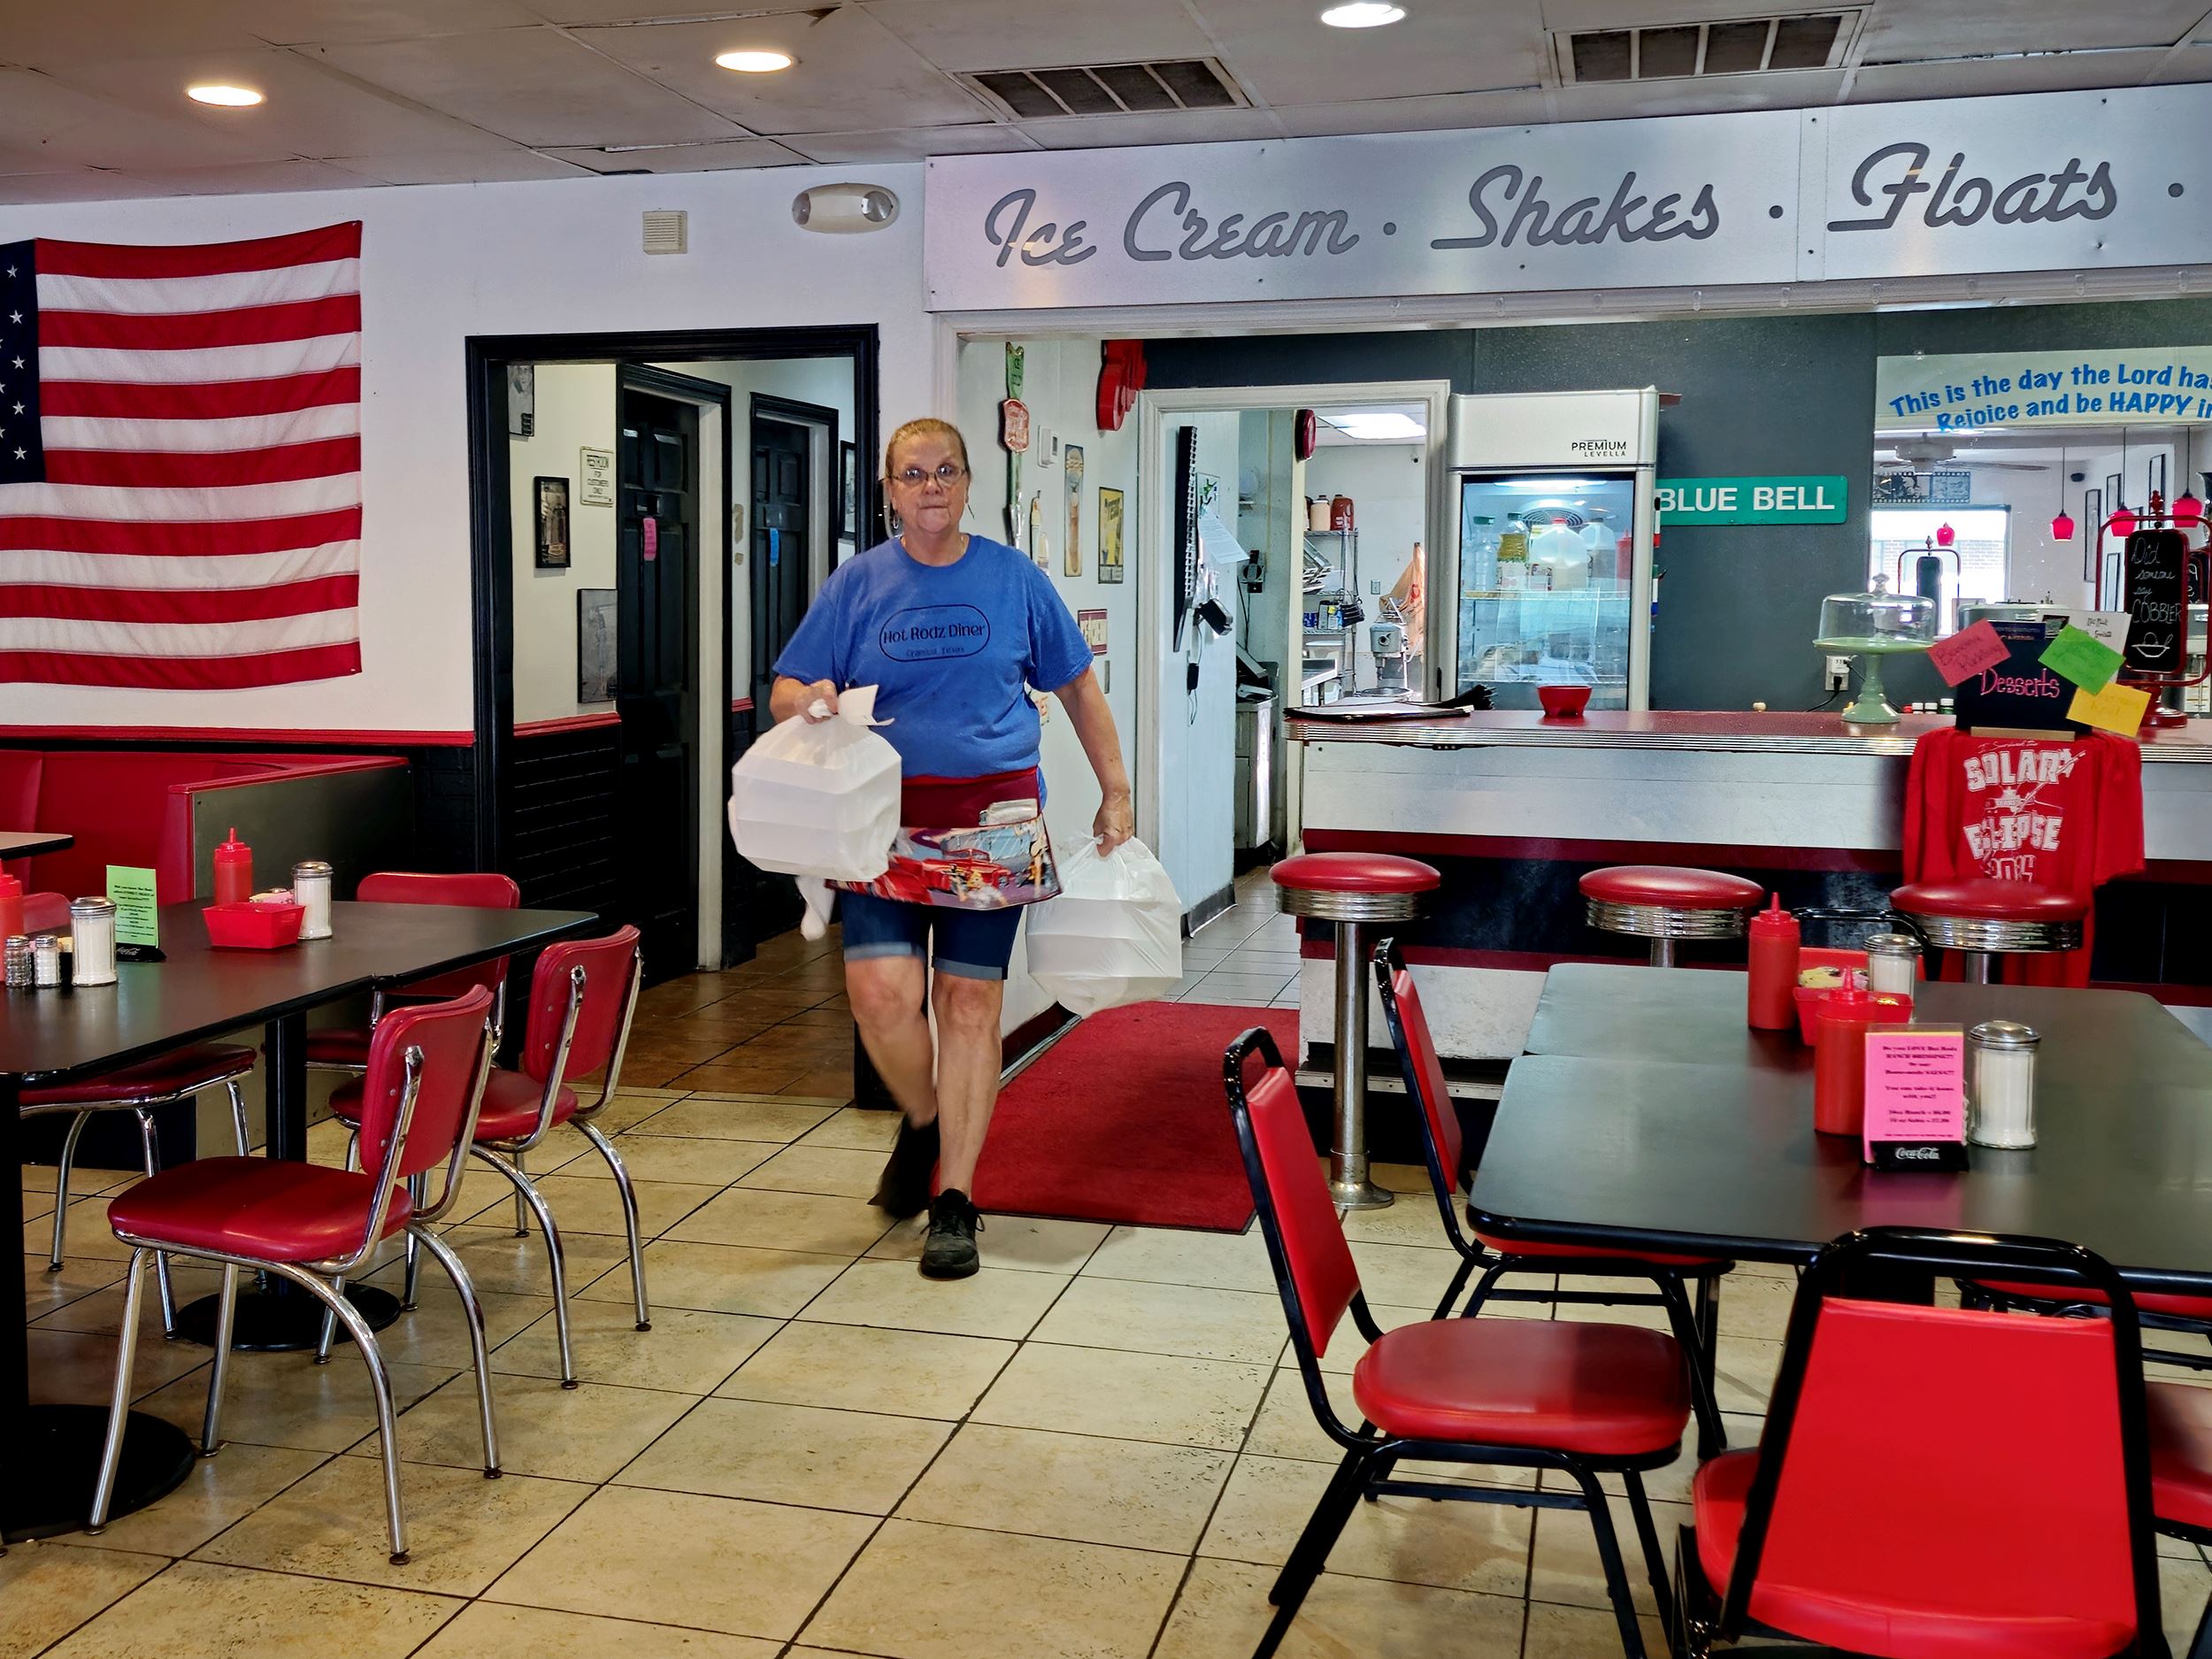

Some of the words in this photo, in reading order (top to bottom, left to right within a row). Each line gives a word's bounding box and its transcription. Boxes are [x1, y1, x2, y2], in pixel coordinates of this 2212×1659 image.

[985, 188, 1097, 268] Ice
[1124, 180, 1360, 261] Cream
[1431, 165, 1719, 250] Shakes
[1826, 142, 2118, 232] Floats
[1889, 392, 1941, 417] This
[1945, 385, 1966, 403] is
[1971, 375, 2011, 397] the
[2018, 369, 2063, 390] day
[2071, 364, 2110, 385] the
[2118, 364, 2173, 386] Lord
[1937, 404, 2019, 432] Rejoice
[2026, 393, 2069, 416] and
[2077, 393, 2102, 413] be
[2109, 392, 2193, 415] HAPPY
[1571, 441, 1626, 450] PREMIUM
[1655, 488, 1738, 511] BLUE
[1754, 486, 1835, 511] BELL
[2131, 537, 2161, 565] Did
[2132, 599, 2182, 624] COBBLER
[883, 629, 909, 643] Hot
[910, 626, 946, 641] Rodz
[949, 623, 986, 637] Diner
[1978, 668, 2060, 698] Desserts
[1963, 749, 2067, 792] SOLAR
[1962, 813, 2063, 860] ECLIPSE
[1895, 1147, 1940, 1160] Coca-Cola
